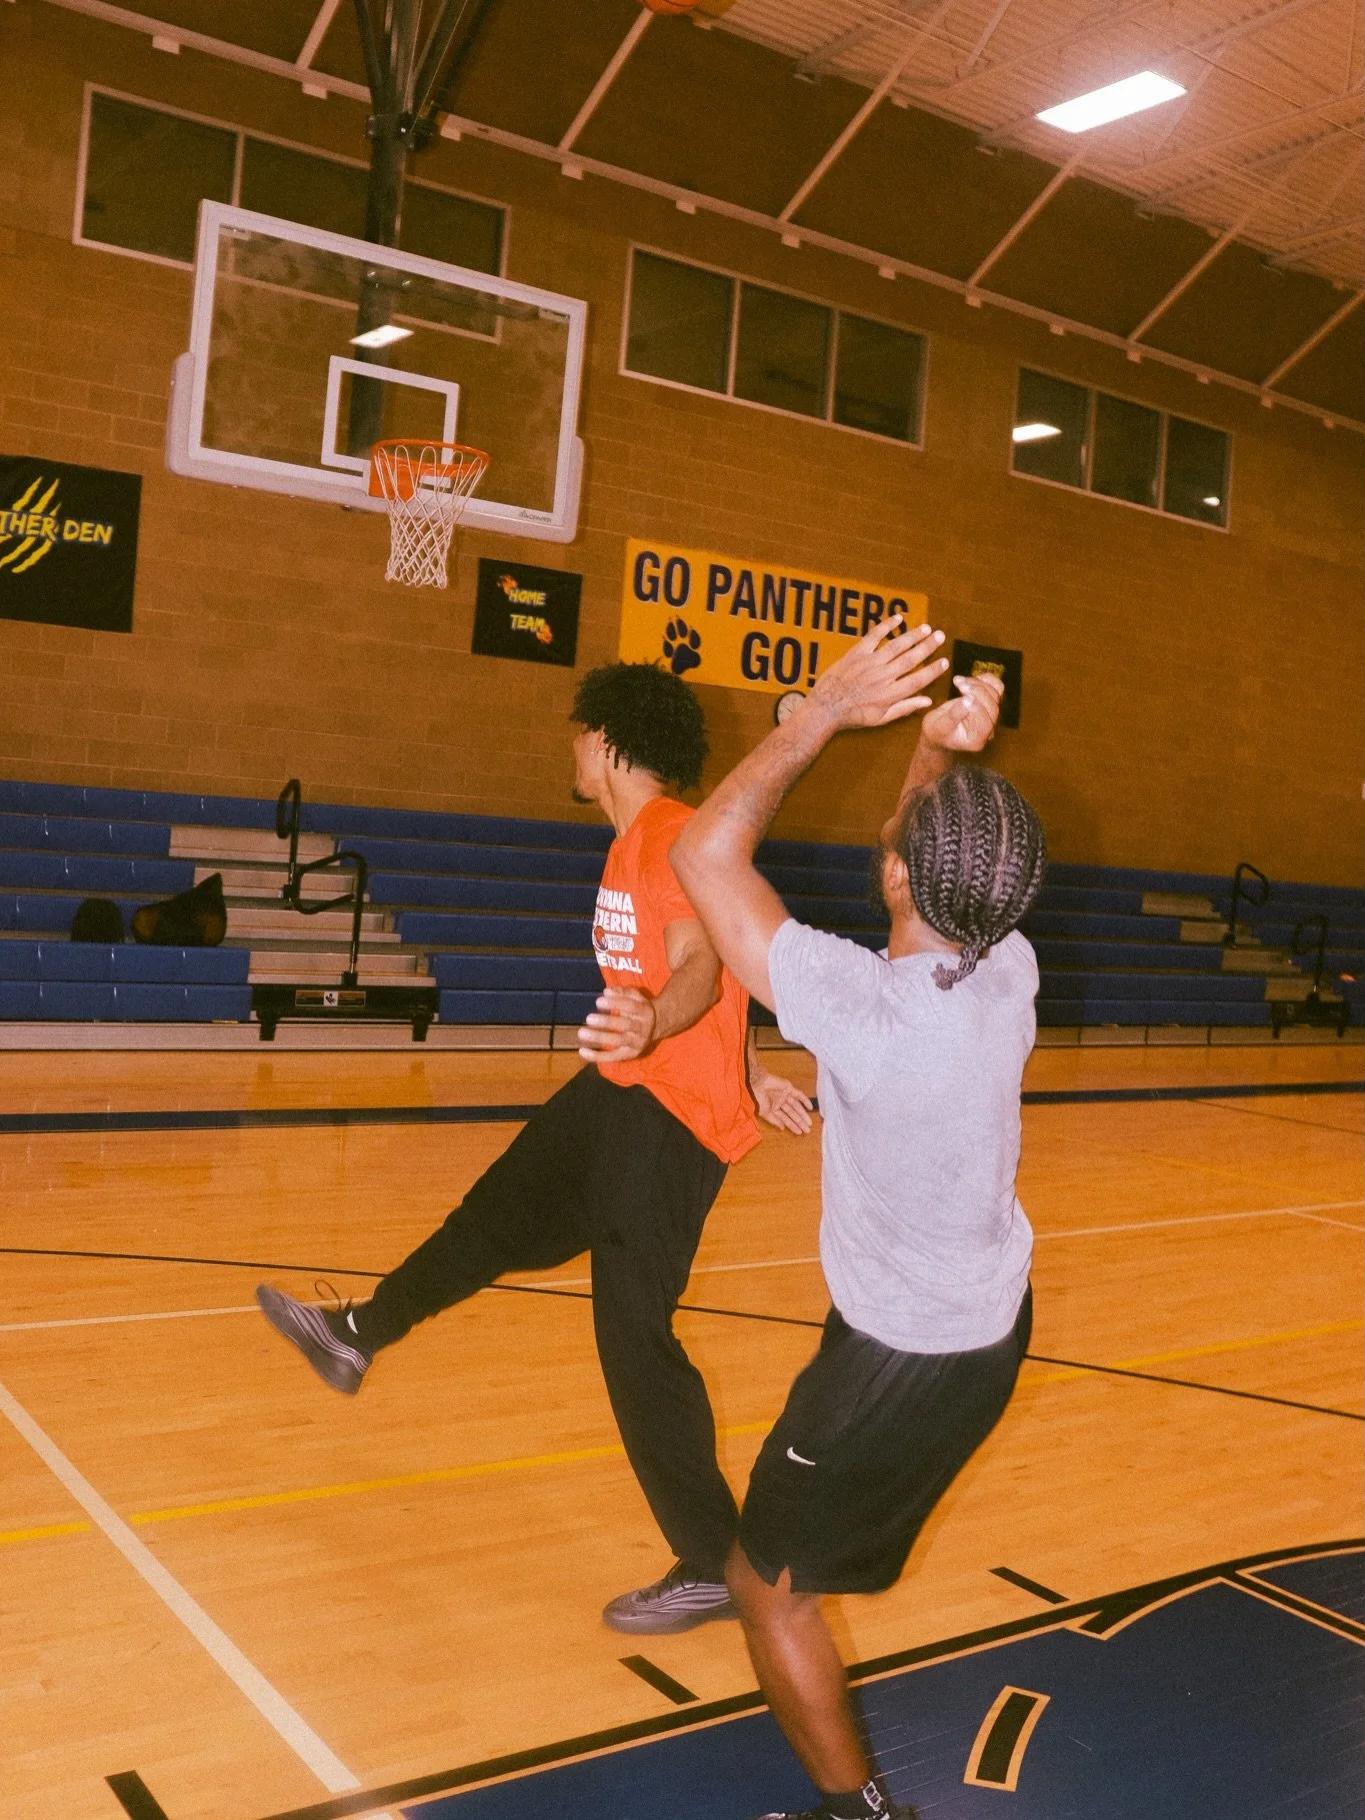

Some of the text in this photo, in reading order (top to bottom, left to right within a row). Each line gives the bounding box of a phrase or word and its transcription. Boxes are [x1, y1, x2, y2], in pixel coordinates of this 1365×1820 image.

[63, 519, 113, 545] DEN
[509, 589, 547, 607] HOME
[633, 550, 909, 641] GO PANTHERS
[510, 613, 546, 633] TEAM
[740, 630, 819, 688] GO!
